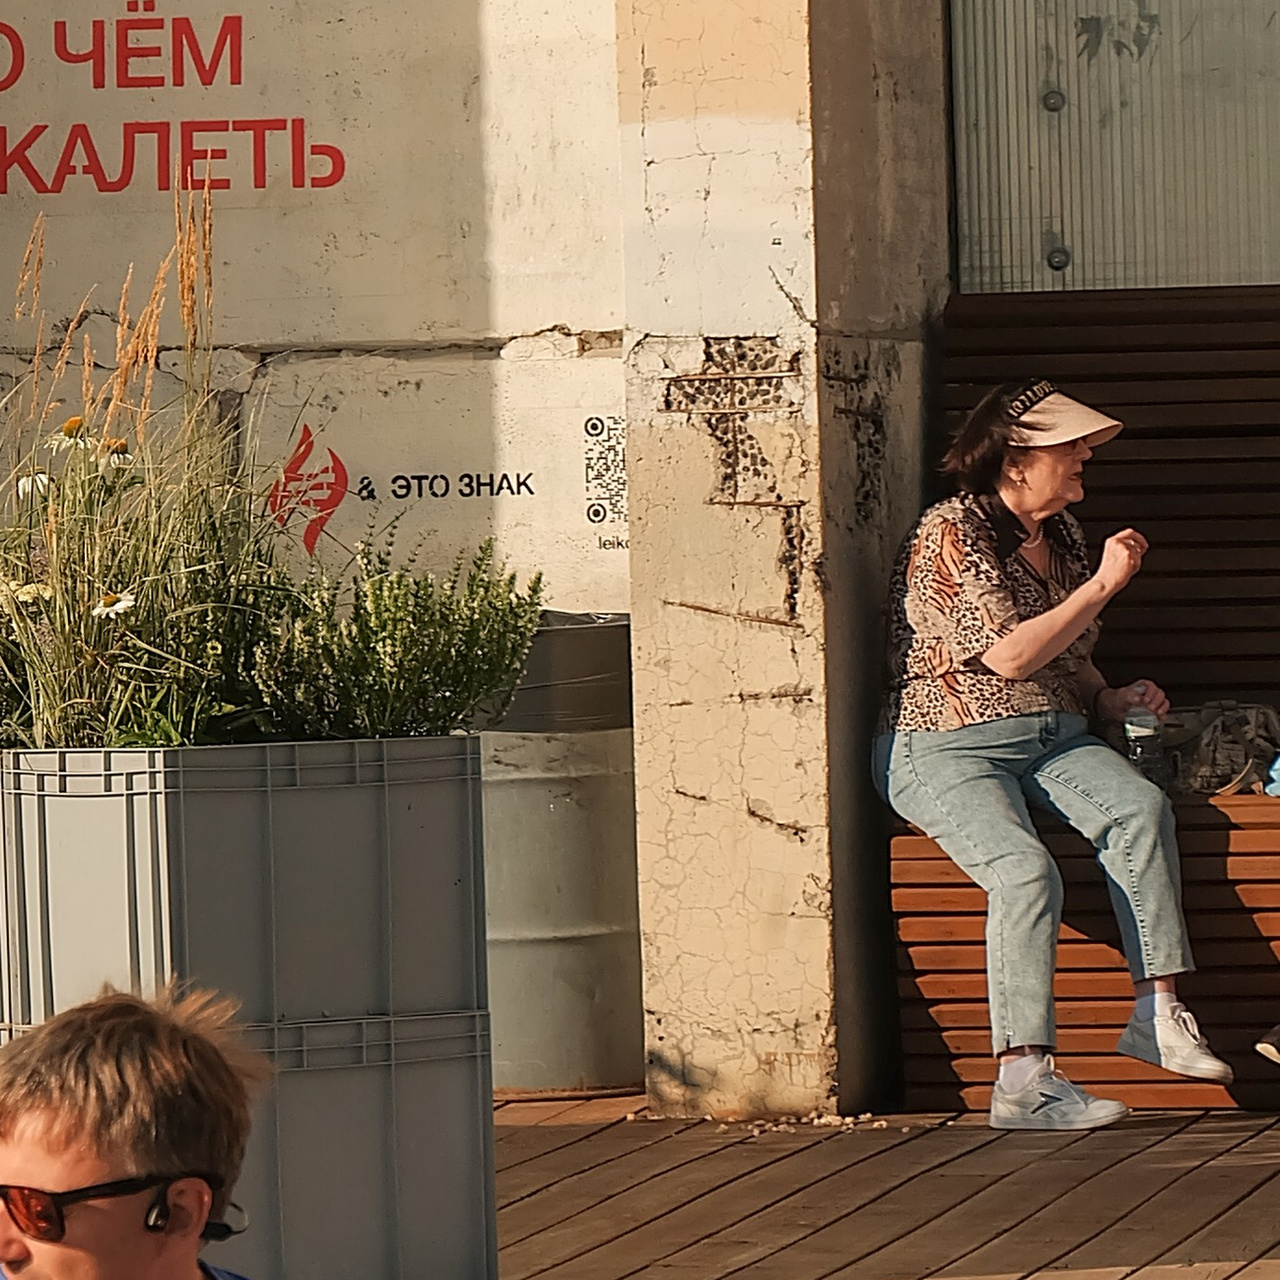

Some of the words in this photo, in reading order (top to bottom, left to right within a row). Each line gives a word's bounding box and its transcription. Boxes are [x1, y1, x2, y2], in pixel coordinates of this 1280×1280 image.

[53, 0, 244, 91] ЧЁМ
[391, 474, 450, 499] ЭТО
[458, 472, 535, 497] ЗНАК
